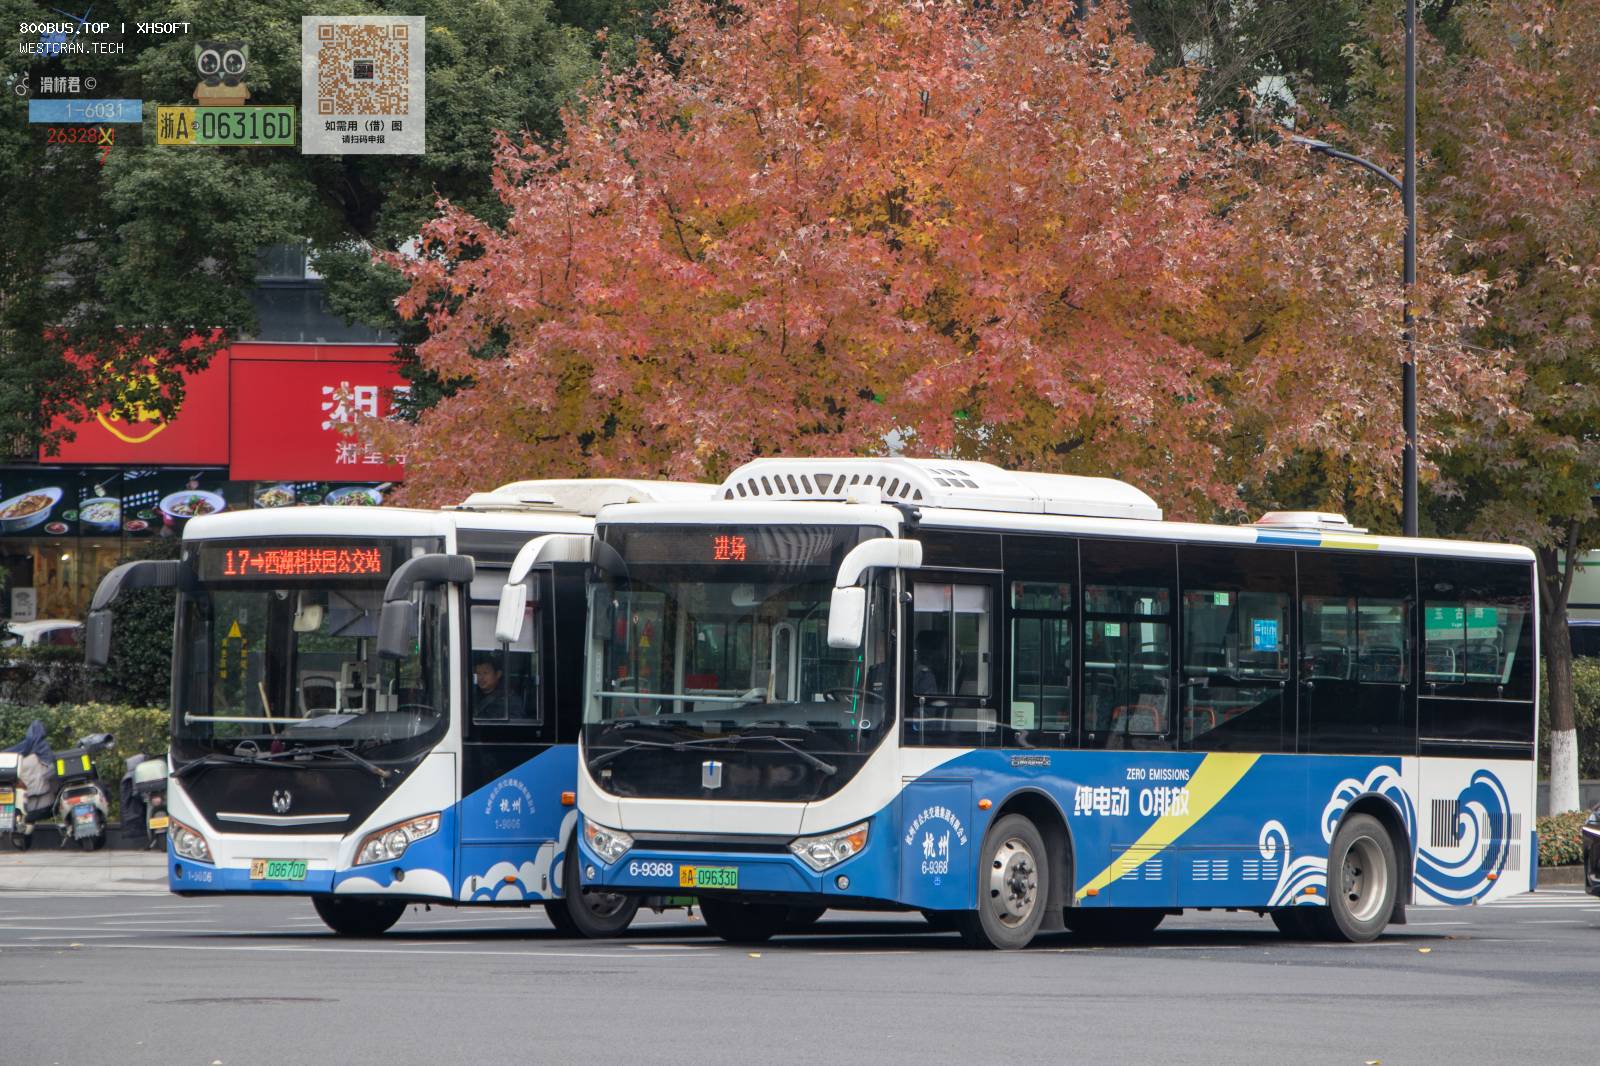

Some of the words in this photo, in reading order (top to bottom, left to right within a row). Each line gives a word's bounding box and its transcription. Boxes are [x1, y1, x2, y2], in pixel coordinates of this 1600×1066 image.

[713, 535, 747, 561] 进场
[1126, 768, 1146, 780] ZERO
[1149, 768, 1190, 780] EMISSIONS
[1074, 786, 1130, 816] 纯电动
[922, 829, 950, 863] 杭州
[629, 863, 673, 877] 6-9368
[921, 860, 948, 874] 6-9368
